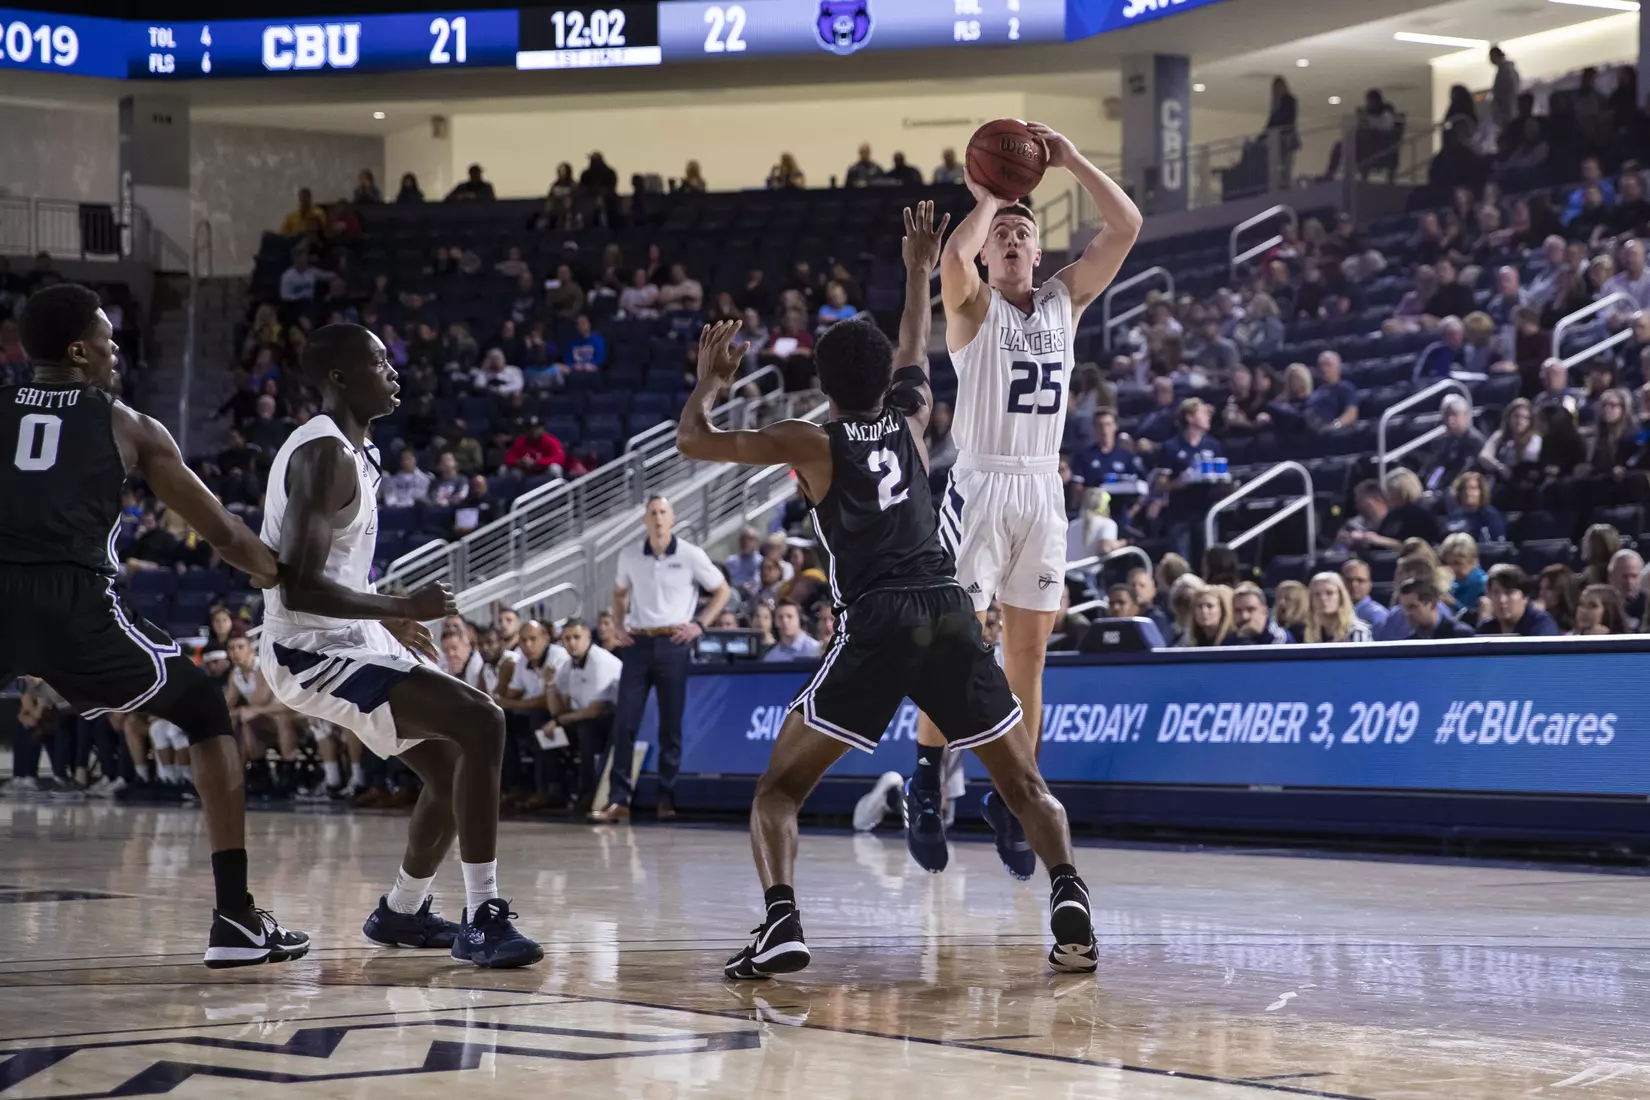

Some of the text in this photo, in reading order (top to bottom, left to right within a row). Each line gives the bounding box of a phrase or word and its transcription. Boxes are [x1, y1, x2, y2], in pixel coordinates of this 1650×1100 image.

[0, 21, 79, 67] 019
[148, 27, 177, 48] TOL
[262, 22, 361, 71] CBU
[429, 16, 467, 64] 21
[550, 9, 626, 48] 12:02
[703, 5, 747, 53] 22
[1008, 17, 1020, 40] 2
[148, 53, 175, 73] FLS
[1007, 361, 1062, 414] 25
[14, 413, 63, 471] 0
[867, 446, 910, 511] 2
[745, 705, 791, 740] SAV
[1041, 703, 1148, 742] UESDAY!
[1157, 702, 1309, 743] DECEMBER
[1309, 702, 1336, 750] 3,
[1341, 701, 1420, 744] 2019
[1434, 700, 1618, 746] #CBUcares
